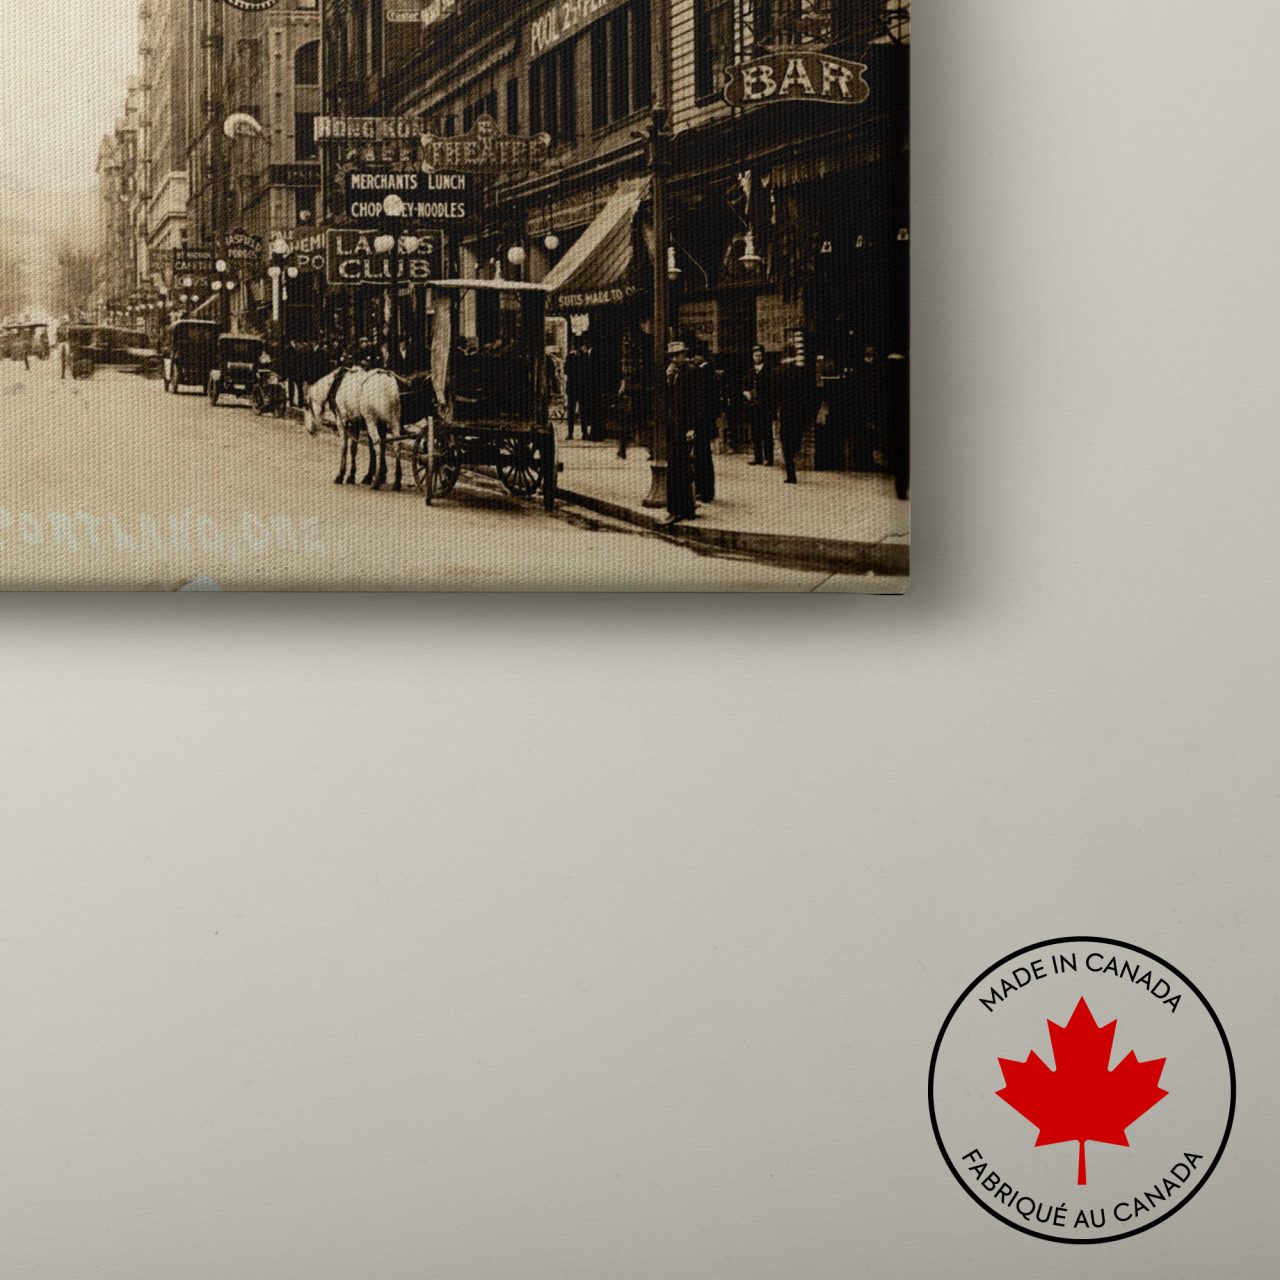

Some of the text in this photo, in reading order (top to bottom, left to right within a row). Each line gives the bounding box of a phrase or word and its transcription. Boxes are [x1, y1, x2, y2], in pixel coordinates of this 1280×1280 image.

[531, 6, 560, 57] POOL
[741, 58, 853, 101] BAR
[351, 174, 466, 190] MERCHANTS LUNCH
[351, 202, 382, 218] CHOP
[338, 258, 432, 279] CLUB
[585, 290, 609, 305] MADE
